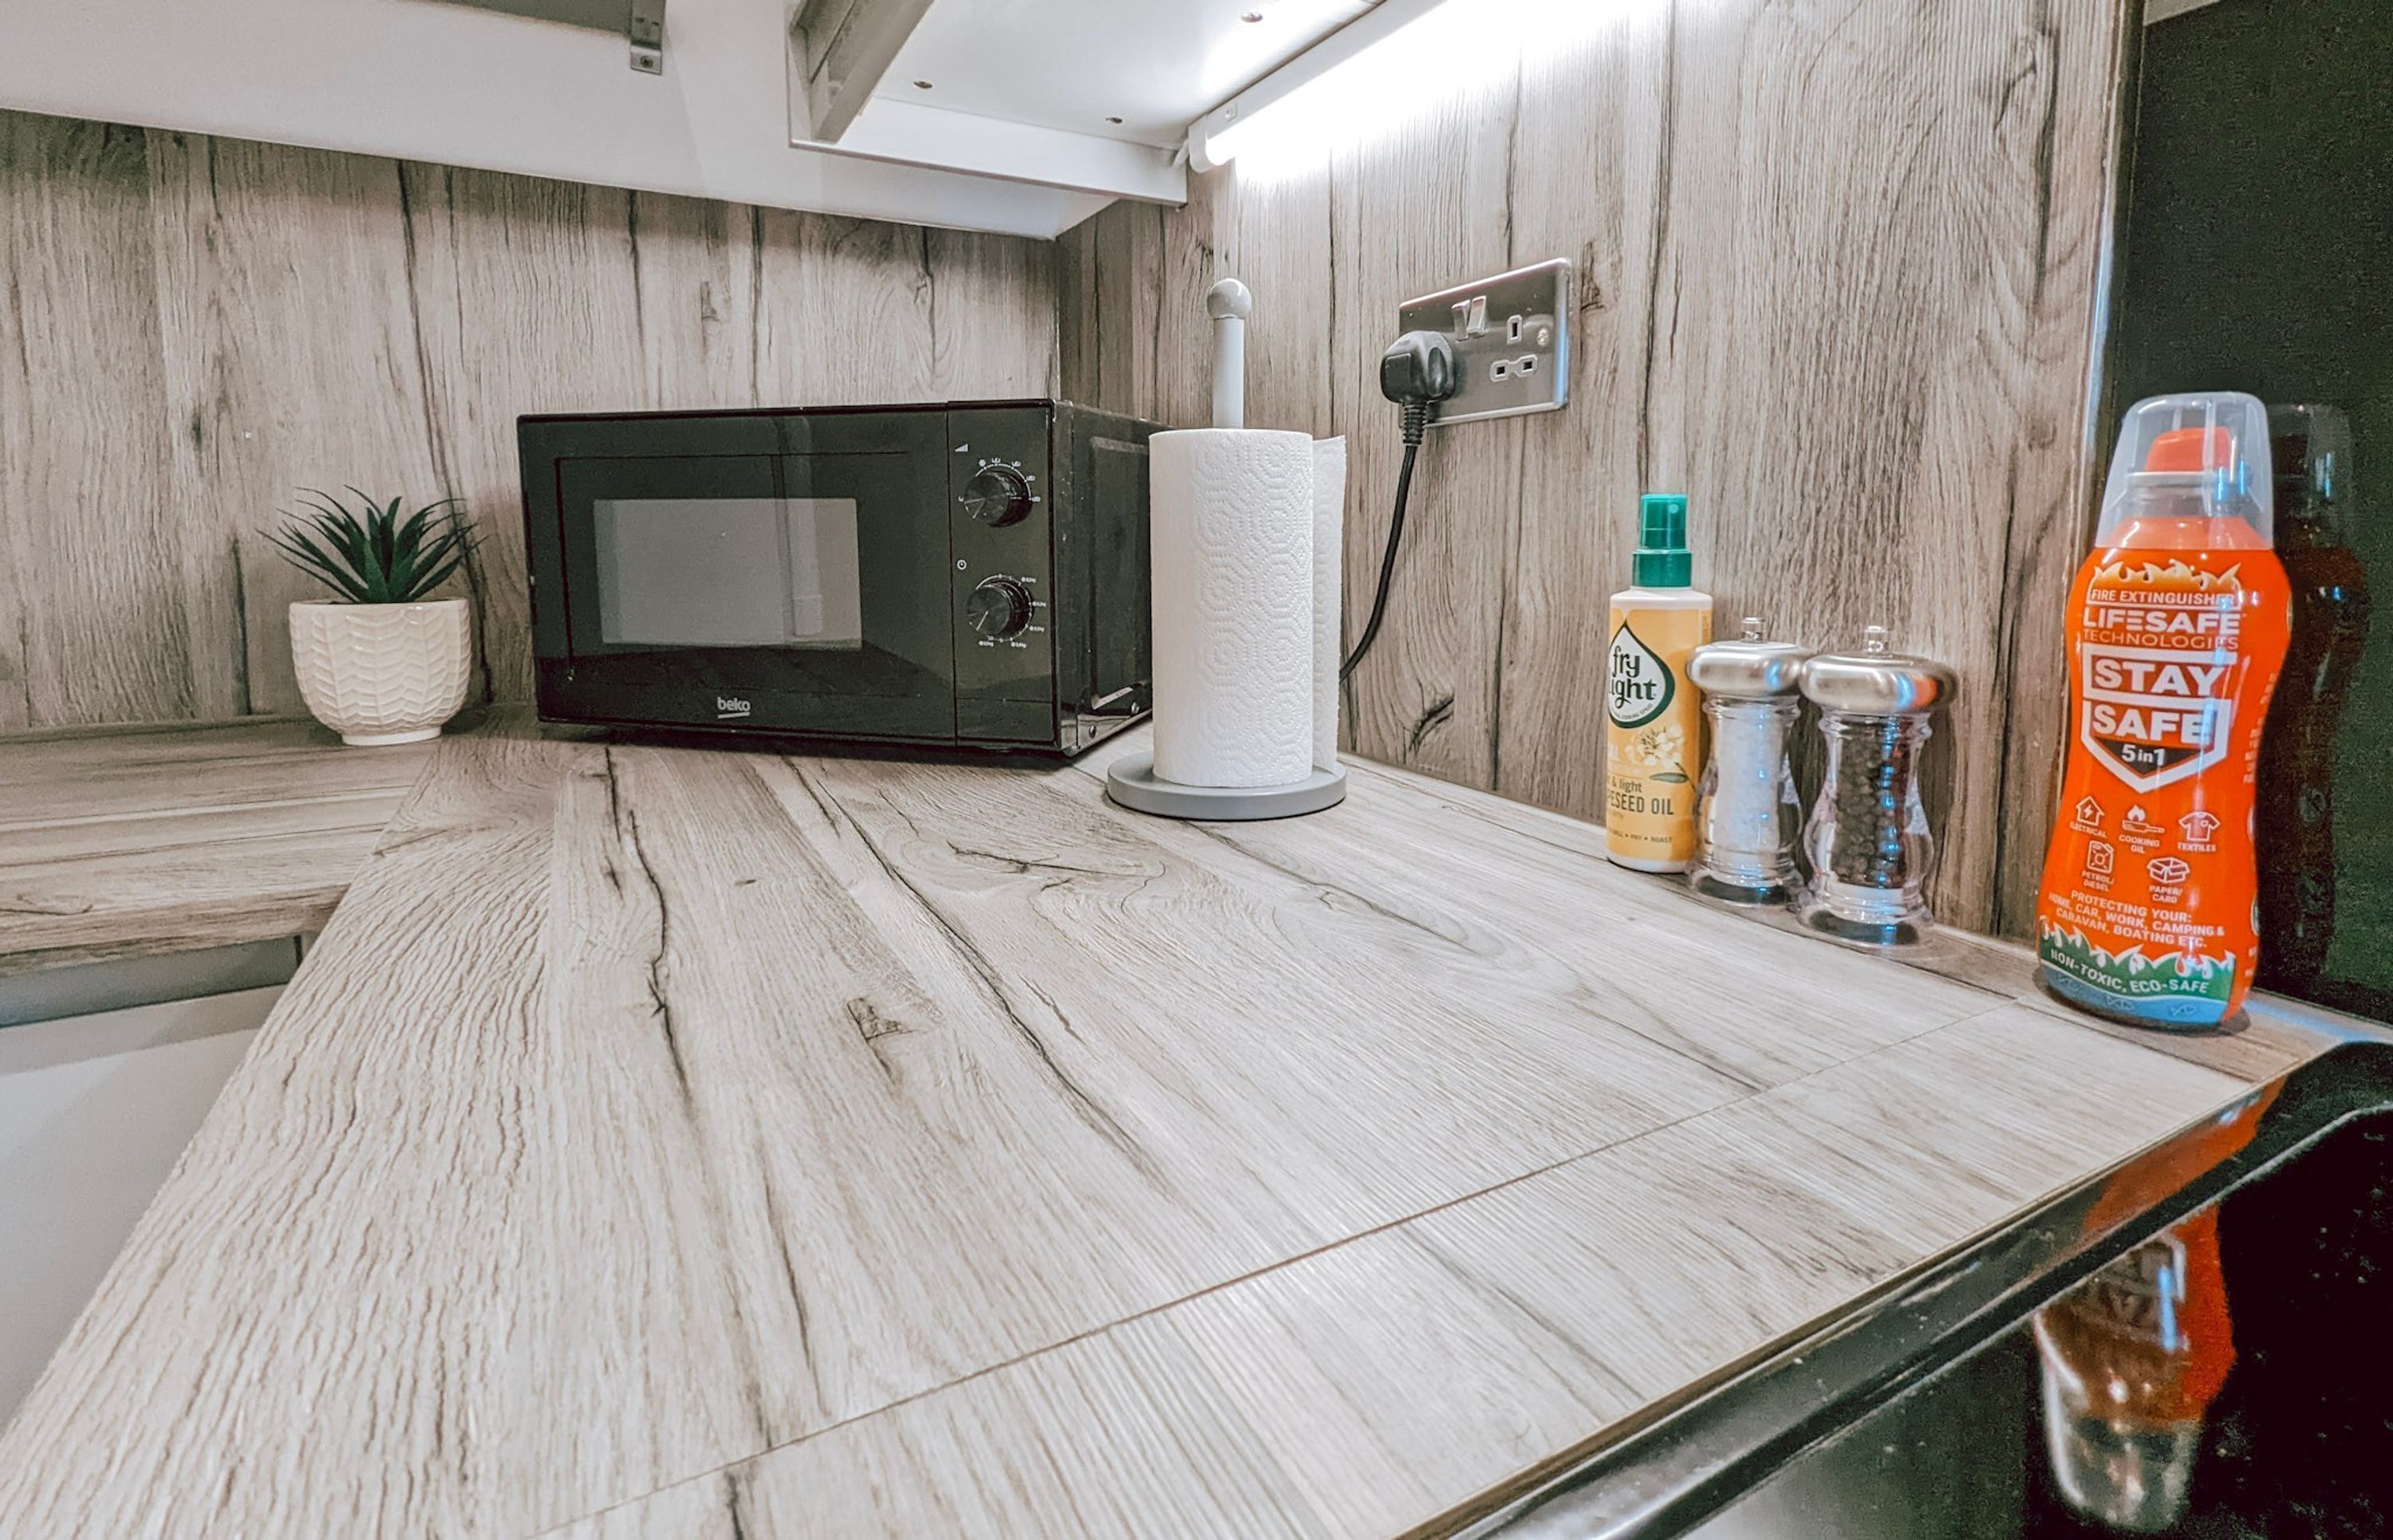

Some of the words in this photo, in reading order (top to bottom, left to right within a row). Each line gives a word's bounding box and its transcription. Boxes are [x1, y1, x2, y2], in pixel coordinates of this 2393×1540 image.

[2091, 589, 2115, 601] FIRE
[2119, 590, 2235, 605] EXTINGUISHER
[2083, 607, 2241, 635] LIFESAFE
[2083, 628, 2239, 649] TECHNOLOGIES
[1611, 645, 1641, 679] fry
[2094, 659, 2225, 696] STAY
[1609, 678, 1658, 709] ight
[717, 696, 751, 711] beko
[2092, 703, 2212, 745] SAFE
[1619, 778, 1643, 794] light
[1651, 798, 1674, 815] OIL
[2069, 821, 2107, 837] ELECTRICAL
[2119, 834, 2160, 848] COOKING
[2131, 844, 2146, 854] OIL
[2177, 842, 2217, 852] TEXTILES
[2084, 880, 2110, 892] DIESEL
[2071, 890, 2147, 916] PROTECTING
[2151, 908, 2192, 923] YOUR:
[2152, 893, 2178, 904] CARD
[2056, 908, 2110, 934] CARAVAN,
[2113, 925, 2175, 945] BOATING
[2178, 936, 2208, 948] ETC.
[2105, 912, 2148, 931] WORK,
[2152, 921, 2214, 936] CAMPING
[2217, 926, 2225, 936] &
[2130, 979, 2210, 994] ECO-SAFE
